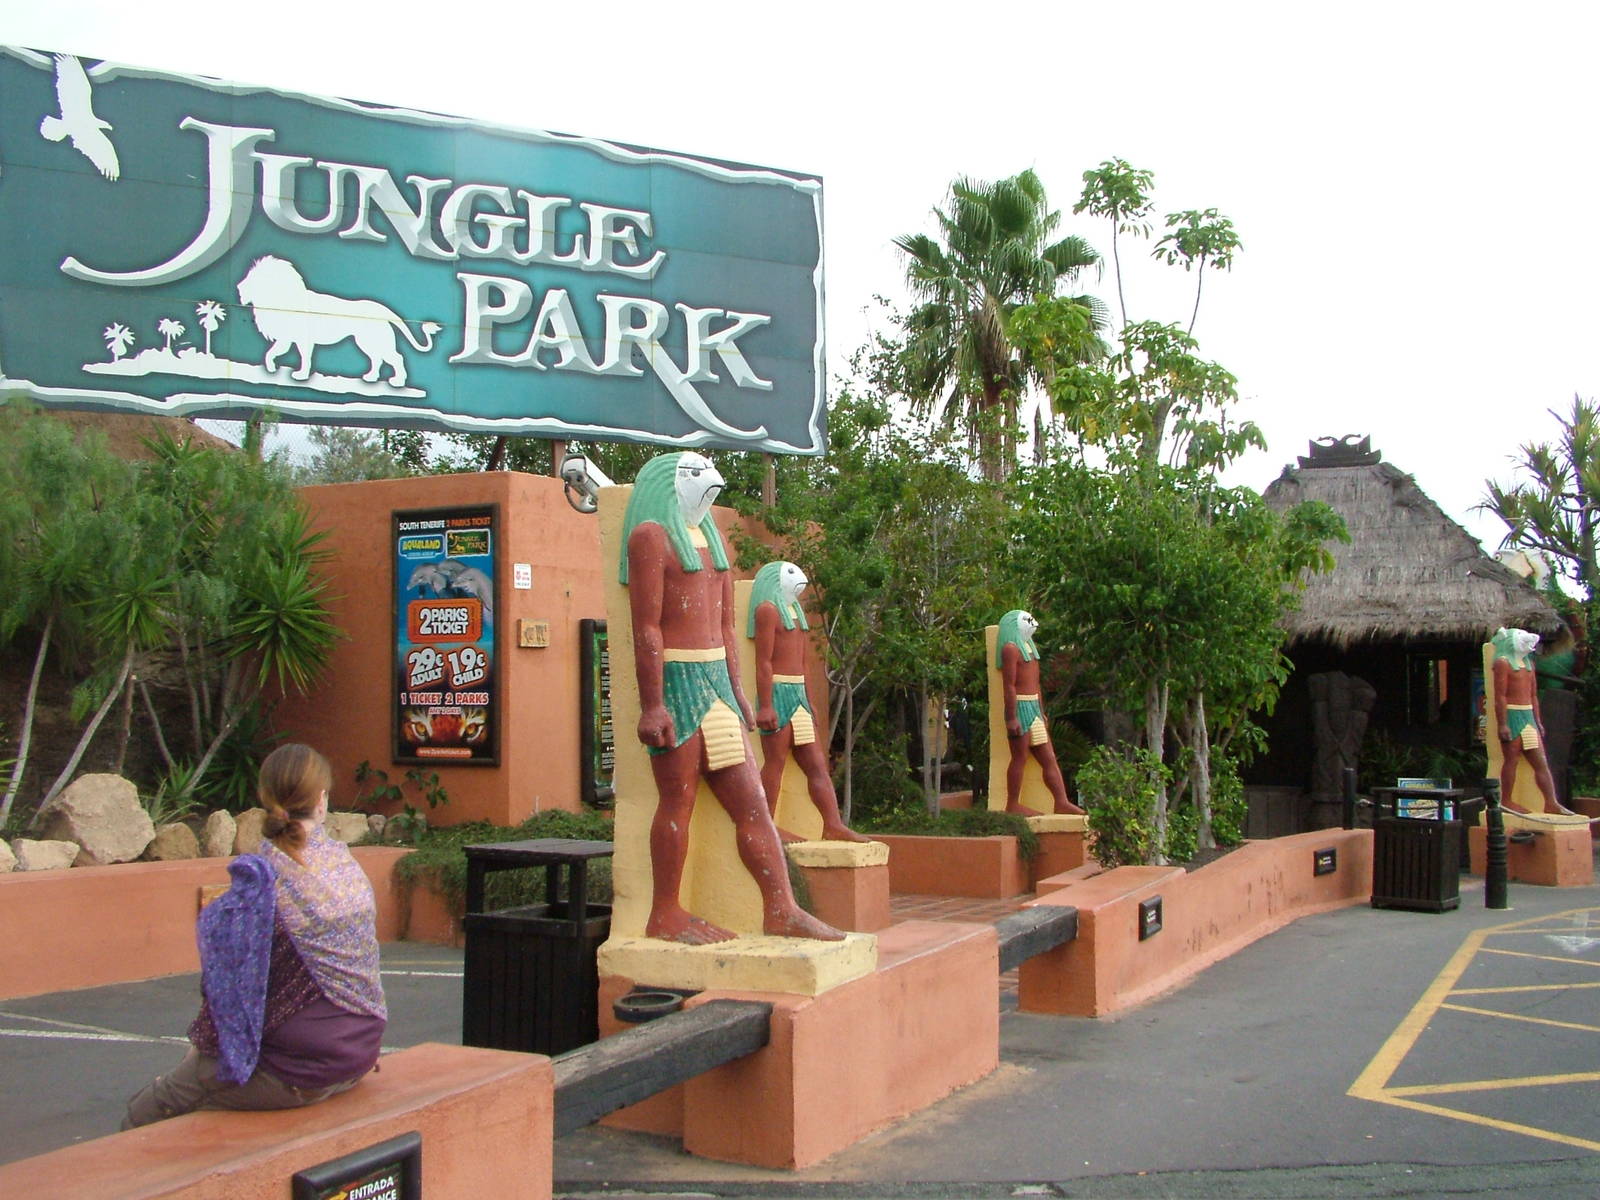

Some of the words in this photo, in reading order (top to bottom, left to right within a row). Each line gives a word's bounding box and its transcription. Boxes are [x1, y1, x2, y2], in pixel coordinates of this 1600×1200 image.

[60, 116, 667, 286] JUNGLE
[449, 271, 772, 440] PARK
[399, 521, 419, 531] SOUTH
[420, 519, 445, 529] TENERIFE
[402, 539, 441, 551] AQUALAND
[419, 608, 432, 635] 2
[431, 608, 468, 622] PARKS
[431, 621, 469, 634] TICKET
[410, 668, 443, 687] ADULT
[452, 668, 484, 686] CHILD
[401, 693, 407, 705] 1
[410, 693, 442, 705] TICKET
[445, 693, 454, 705] 2
[456, 692, 489, 705] PARKS
[349, 1175, 395, 1200] ENTRADA
